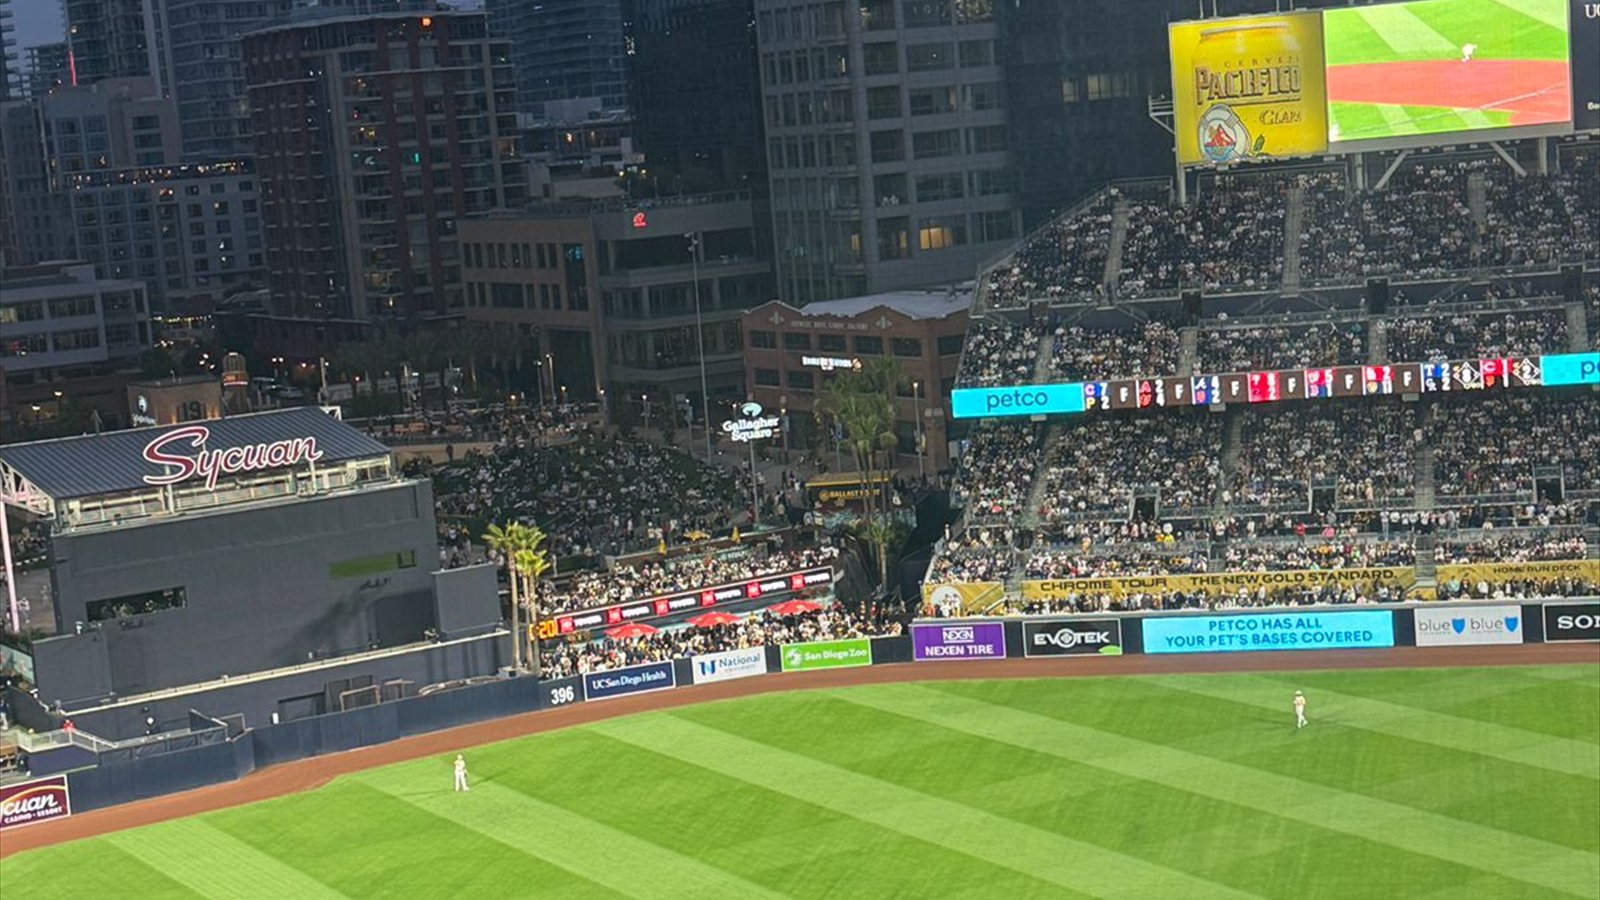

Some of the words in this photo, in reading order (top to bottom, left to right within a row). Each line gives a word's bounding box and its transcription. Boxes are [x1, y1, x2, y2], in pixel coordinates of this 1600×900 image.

[1324, 370, 1333, 383] 5
[1382, 366, 1391, 379] 2
[1441, 363, 1450, 377] 2
[1522, 365, 1531, 380] 2
[1581, 360, 1600, 380] p
[1155, 379, 1164, 393] 2
[1288, 378, 1296, 393] F
[1345, 374, 1354, 389] F
[1403, 371, 1412, 387] F
[1442, 378, 1451, 391] 2
[1100, 382, 1108, 396] 7
[1175, 384, 1184, 399] F
[1231, 381, 1240, 396] F
[1268, 386, 1276, 400] 2
[1326, 383, 1333, 397] 1
[1382, 380, 1393, 394] 11
[987, 390, 1048, 412] petco
[1120, 387, 1129, 402] F
[1212, 390, 1220, 403] 2
[1100, 396, 1110, 410] 2
[722, 417, 779, 432] Gallagher
[732, 429, 772, 442] Square
[143, 426, 323, 491] Sycuan
[1040, 580, 1112, 591] CHROME
[1118, 578, 1167, 588] TOUR
[1190, 576, 1220, 586] THE
[1224, 574, 1259, 585] NEW
[1262, 573, 1305, 584] GOLD
[1308, 569, 1398, 582] STANDARD.
[1209, 619, 1258, 631] PETCO
[1262, 618, 1292, 630] HAS
[1296, 618, 1322, 629] ALL
[1418, 619, 1451, 631] blue
[1470, 618, 1503, 630] blue
[1034, 628, 1110, 648] EVOTEK
[1165, 635, 1204, 648] YOUR
[1209, 634, 1248, 646] PET'S
[1252, 632, 1298, 645] BASES
[1301, 630, 1373, 643] COVERED
[804, 652, 822, 660] San
[822, 650, 848, 660] Diego
[848, 648, 868, 657] Zoo
[925, 644, 964, 656] NEXEN
[966, 644, 994, 655] TIRE
[720, 653, 760, 667] National
[620, 676, 642, 686] Diego
[642, 670, 666, 682] Health
[551, 686, 574, 704] 396
[4, 813, 33, 824] CASINO
